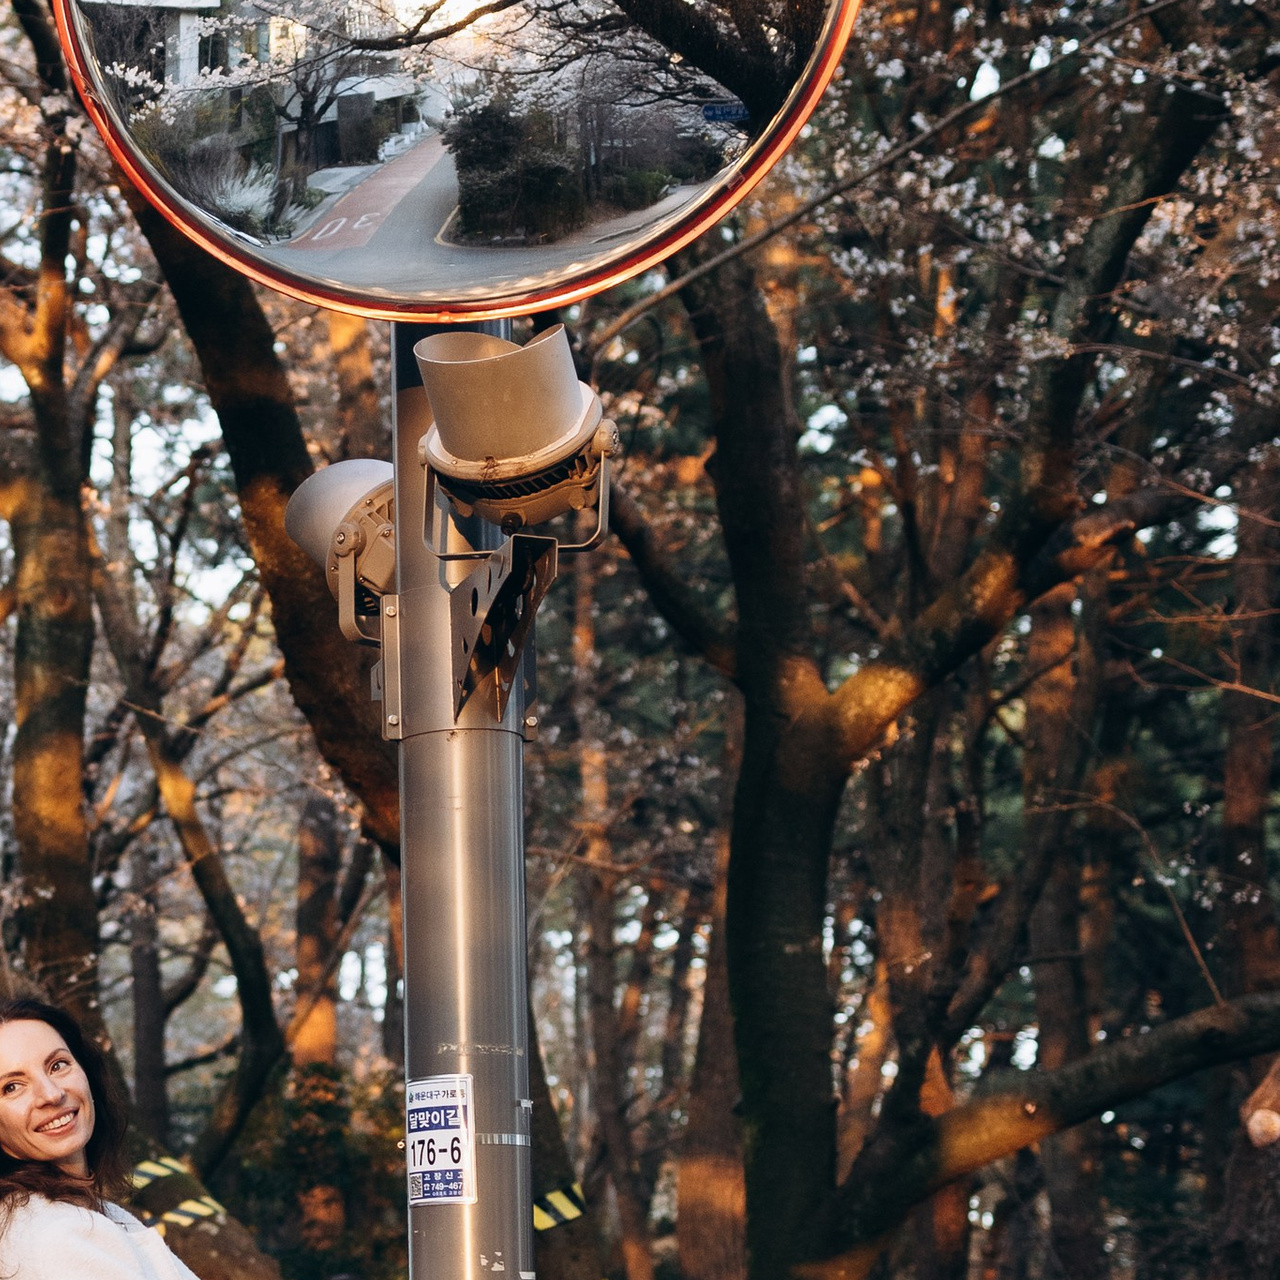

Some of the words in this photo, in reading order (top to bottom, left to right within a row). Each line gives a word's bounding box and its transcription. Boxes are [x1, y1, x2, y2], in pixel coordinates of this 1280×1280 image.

[409, 1109, 461, 1130] 달맞이길
[411, 1136, 461, 1167] 176-6
[431, 1182, 463, 1191] 749-467
